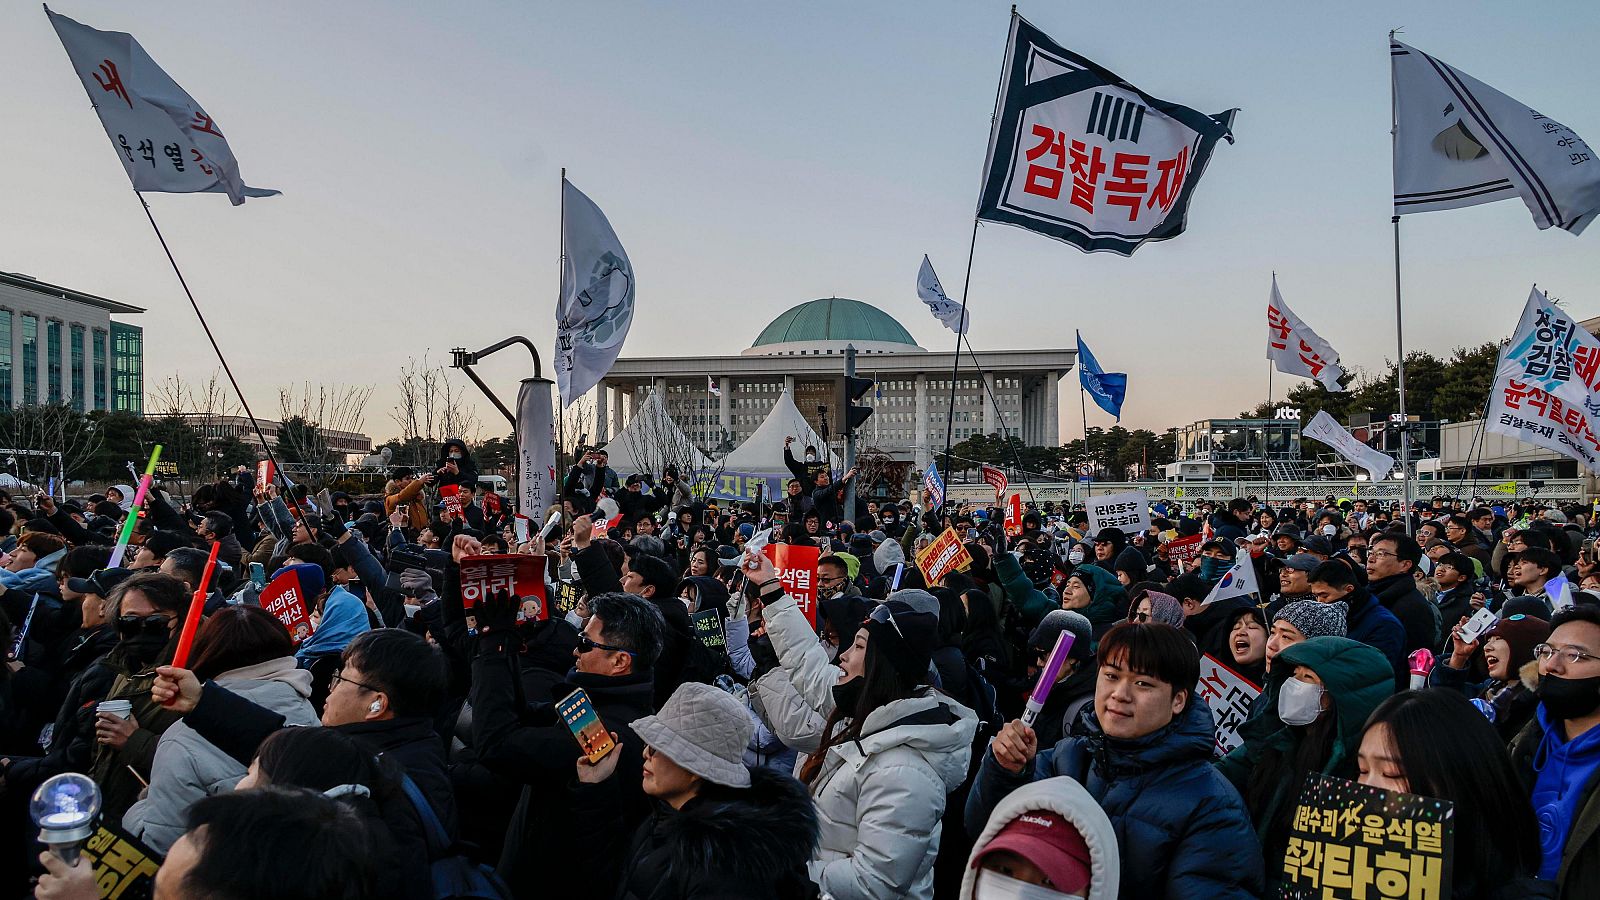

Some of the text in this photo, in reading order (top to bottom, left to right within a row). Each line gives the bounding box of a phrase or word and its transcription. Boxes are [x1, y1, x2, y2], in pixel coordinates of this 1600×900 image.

[118, 133, 185, 172] 윤석열
[1023, 123, 1188, 222] 검찰독재
[1535, 308, 1576, 352] 정치
[1525, 344, 1573, 381] 검찰
[1573, 345, 1600, 393] 해
[1274, 405, 1301, 420] jtbc
[1499, 412, 1555, 439] 검찰독재
[1095, 501, 1138, 516] 수호하라
[1097, 513, 1141, 528] 민주주의
[594, 518, 609, 530] 핵
[461, 575, 518, 603] 하라
[786, 591, 811, 613] 라
[1362, 813, 1443, 854] 윤석열
